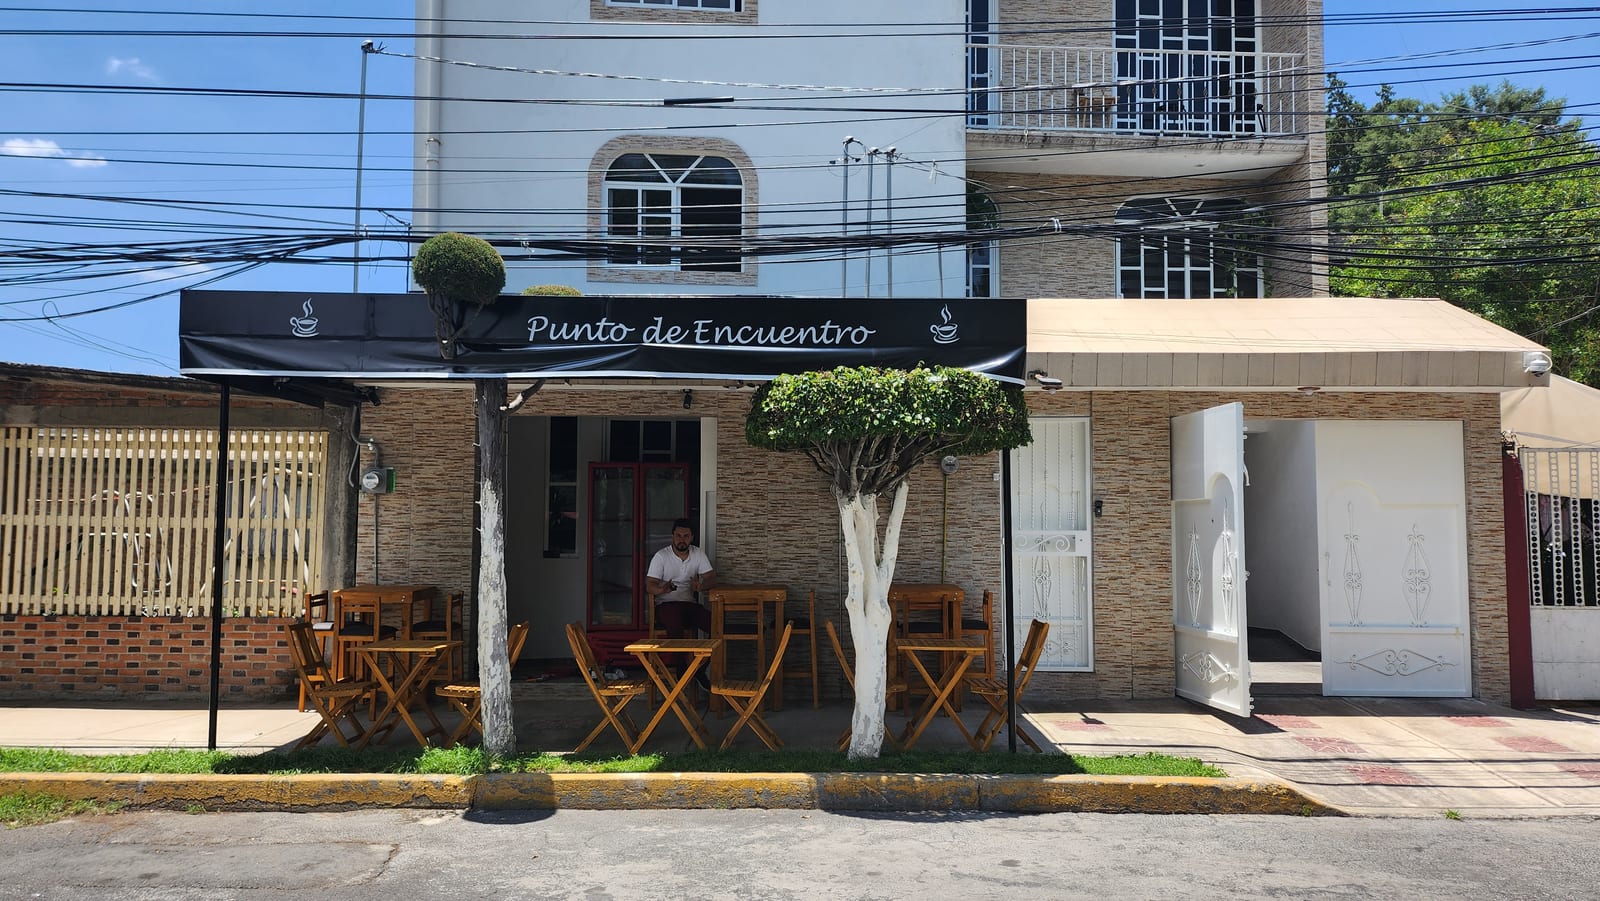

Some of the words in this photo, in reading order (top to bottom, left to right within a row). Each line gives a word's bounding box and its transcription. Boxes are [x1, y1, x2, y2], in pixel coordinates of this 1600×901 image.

[527, 315, 636, 342] Punto
[641, 316, 690, 345] de
[693, 319, 877, 345] Encuentro
